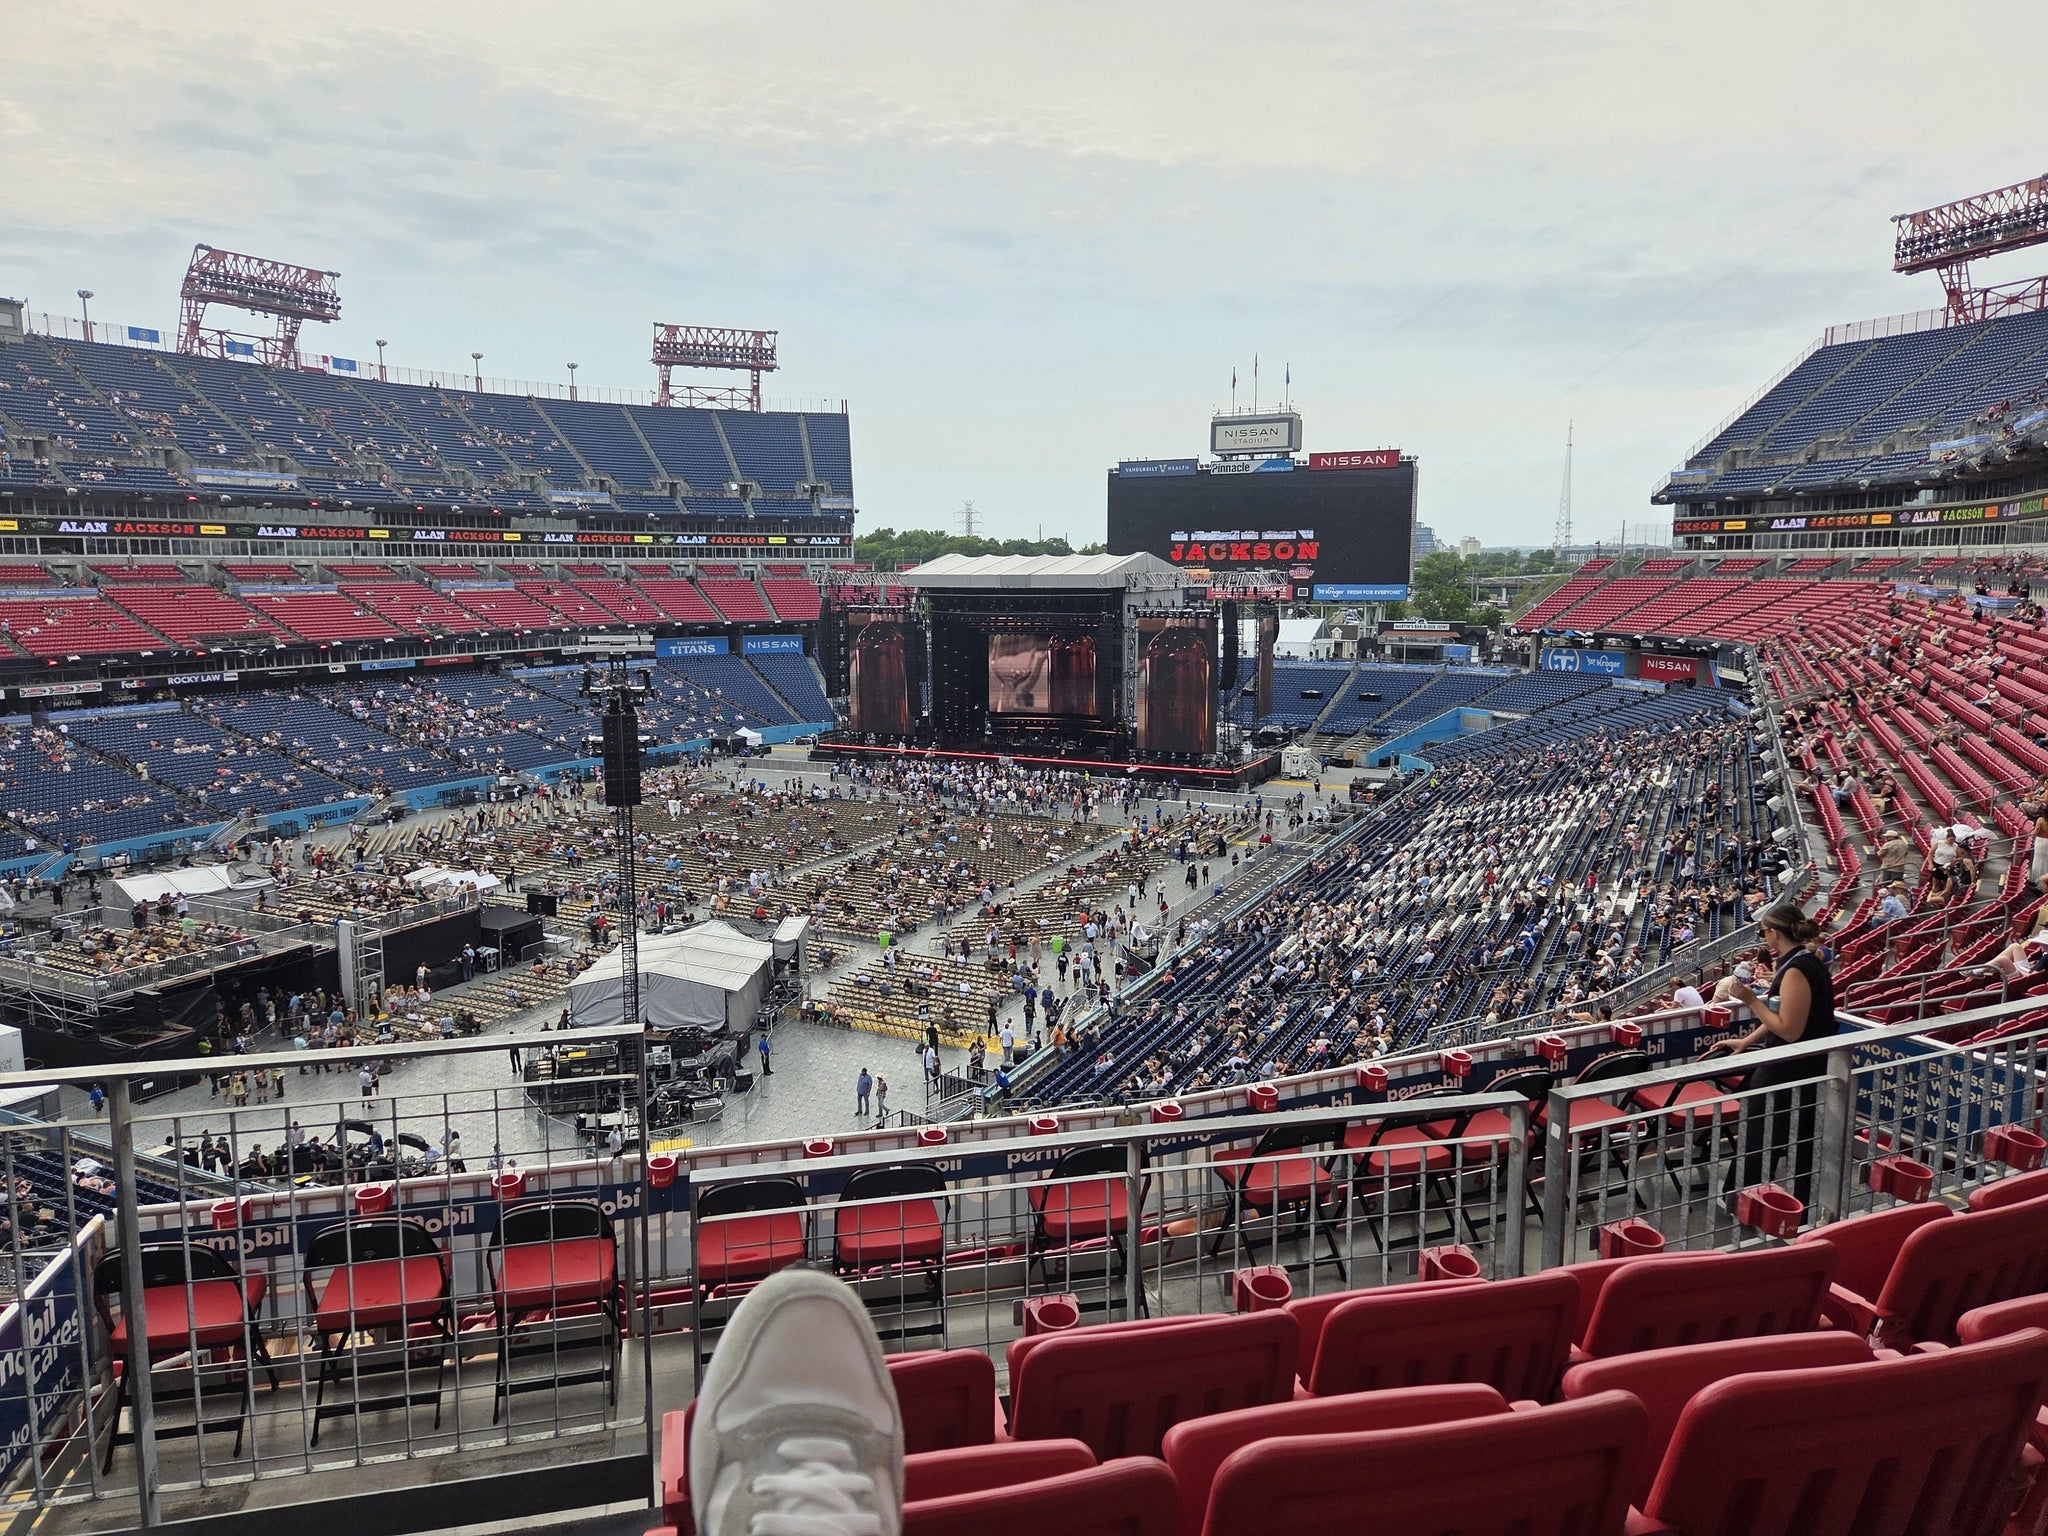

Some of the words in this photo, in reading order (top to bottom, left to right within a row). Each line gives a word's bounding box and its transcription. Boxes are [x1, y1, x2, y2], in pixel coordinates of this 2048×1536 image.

[1224, 427, 1279, 438] NISSAN
[1233, 437, 1269, 445] STADIUM
[1320, 455, 1387, 467] NISSAN
[1211, 462, 1250, 473] Pinnacle
[1912, 510, 1940, 523] ALAN
[1942, 507, 1984, 521] JACKSON
[1675, 521, 1720, 532] CKSON
[1771, 517, 1807, 529] ALAN
[1809, 513, 1869, 528] JACKSON
[58, 521, 108, 533] ALAN
[114, 523, 195, 534] JACKSON
[257, 526, 298, 537] ALAN
[300, 527, 365, 538] JACKSON
[413, 530, 446, 540] ALAN
[448, 531, 500, 541] JACKSON
[543, 533, 574, 543] ALAN
[576, 534, 631, 543] JACKSON
[676, 535, 707, 544] ALAN
[709, 536, 765, 545] JACKSON
[809, 536, 841, 545] ALAN
[1170, 541, 1320, 561] JACKSON
[1325, 587, 1344, 598] Kroger
[669, 644, 716, 654] TITANS
[747, 640, 799, 649] NISSAN
[380, 660, 408, 669] Gallagher
[1596, 655, 1620, 673] Kroger
[1647, 659, 1691, 672] NISSAN
[121, 679, 149, 689] FedEx
[168, 675, 199, 685] ROCKY
[200, 673, 221, 683] LAW
